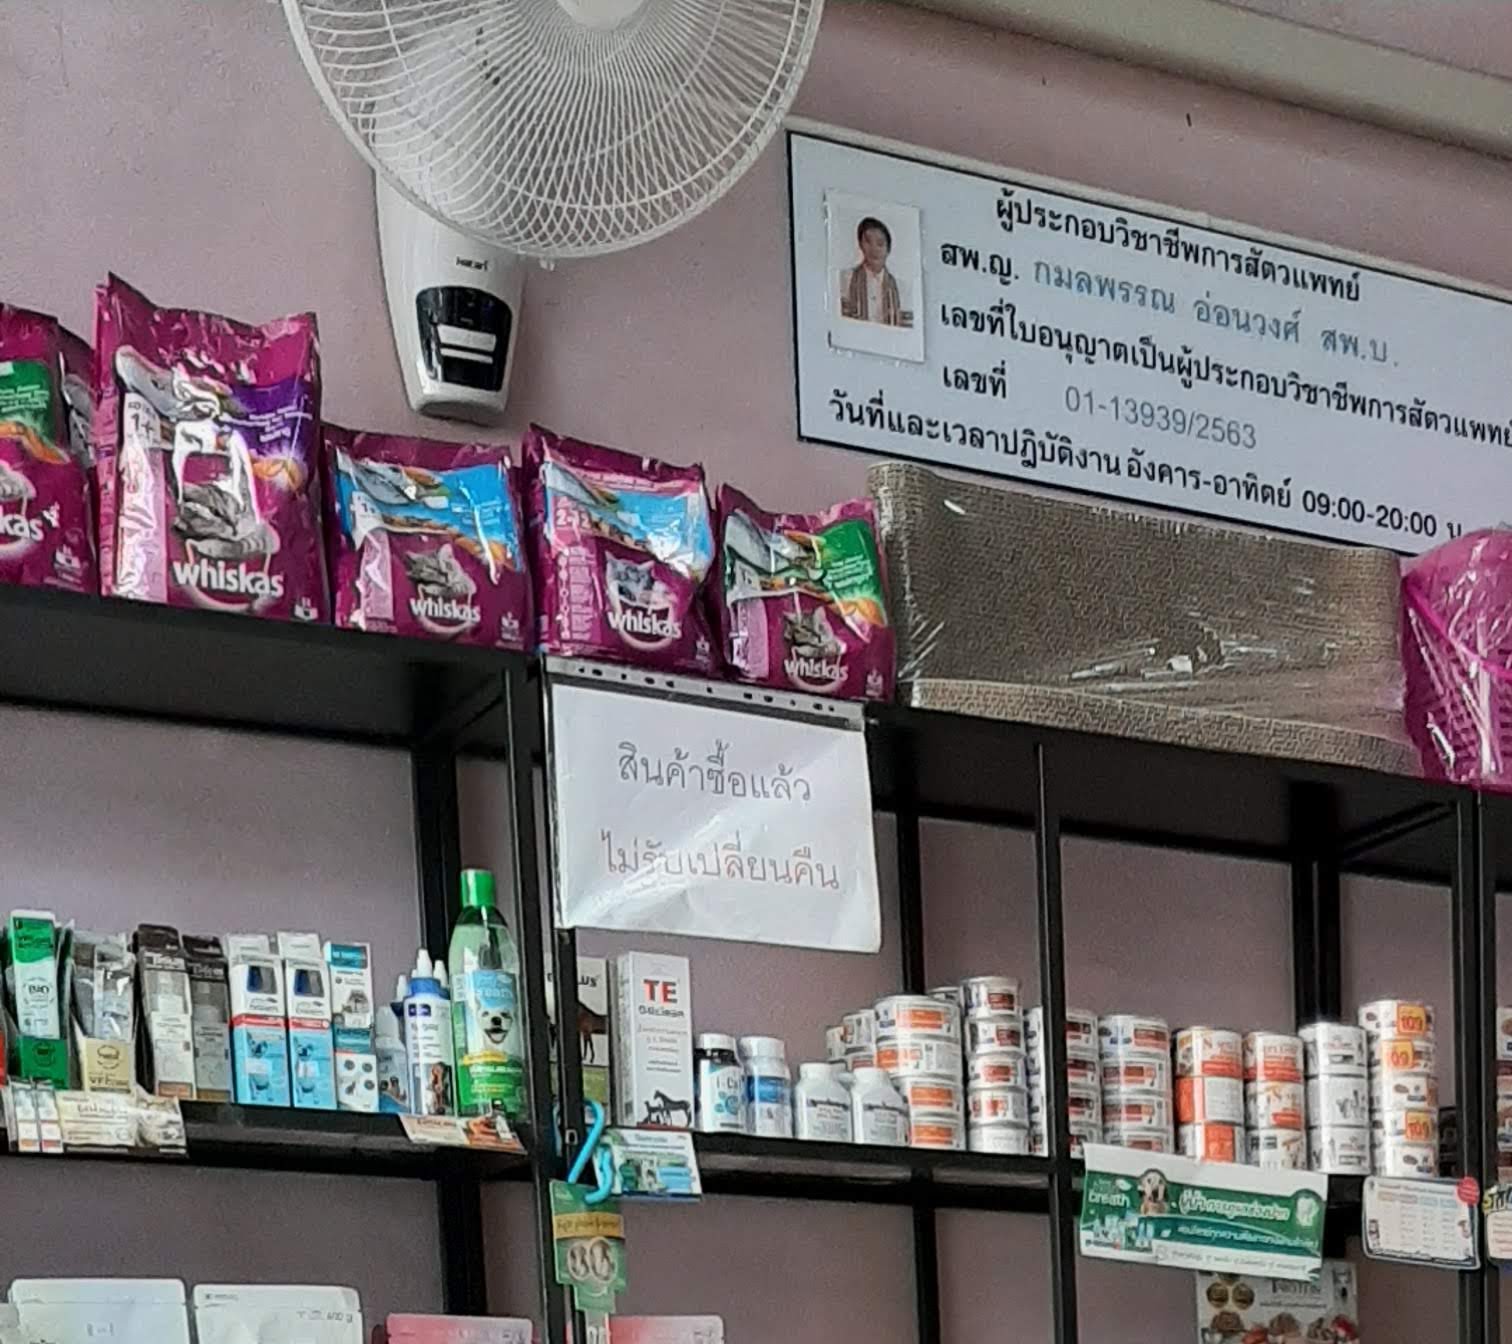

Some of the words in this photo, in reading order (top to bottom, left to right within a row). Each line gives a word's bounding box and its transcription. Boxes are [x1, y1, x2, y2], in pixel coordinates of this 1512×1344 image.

[996, 190, 1361, 303] ผู้ประกอบวิชาชีพการสัตวแพทย์
[939, 242, 1020, 288] สพ.ญ.
[1033, 259, 1176, 315] กมลพรรณ
[1193, 291, 1301, 345] อ่อนวงศ์
[1320, 328, 1399, 367] สพ.บ.
[942, 360, 1007, 399] เลขที่
[1064, 385, 1257, 450] 01-13939/2563
[1127, 447, 1293, 509] อังคาร-อาทิตย์
[1301, 489, 1438, 538] 09:00-20:00
[172, 557, 285, 599] whiskas
[409, 596, 482, 624] whiskas
[607, 608, 682, 639] whiskas
[783, 658, 849, 683] whiskas
[618, 739, 811, 802] สินค้าซื้อแล้ว
[600, 829, 840, 890] ไม่รับเปลี่ยนคืน
[643, 978, 679, 1004] TE
